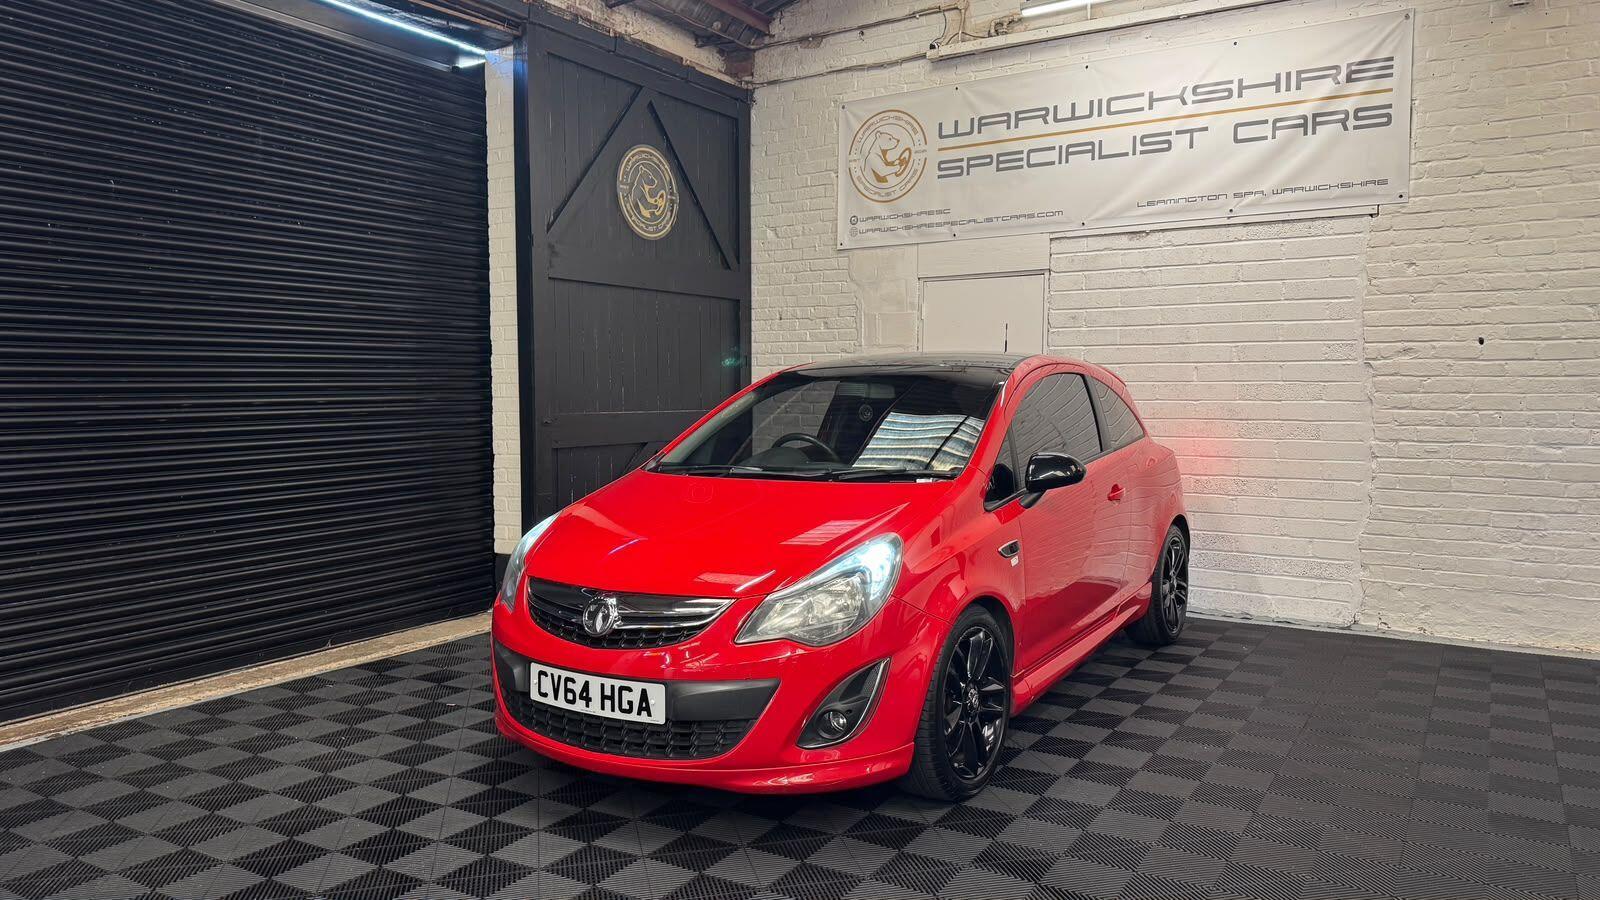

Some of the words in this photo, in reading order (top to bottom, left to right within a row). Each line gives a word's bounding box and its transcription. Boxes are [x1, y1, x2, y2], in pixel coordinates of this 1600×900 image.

[938, 56, 1395, 140] WARWICKSHIRE
[937, 126, 1209, 179] SPECIALIST
[1233, 103, 1393, 144] CARS
[1136, 193, 1228, 208] LEAMINGTON
[1233, 189, 1268, 199] SPA,
[1271, 178, 1389, 196] WARWICKSHIRE
[537, 669, 593, 708] CV64
[600, 683, 653, 718] HGA
